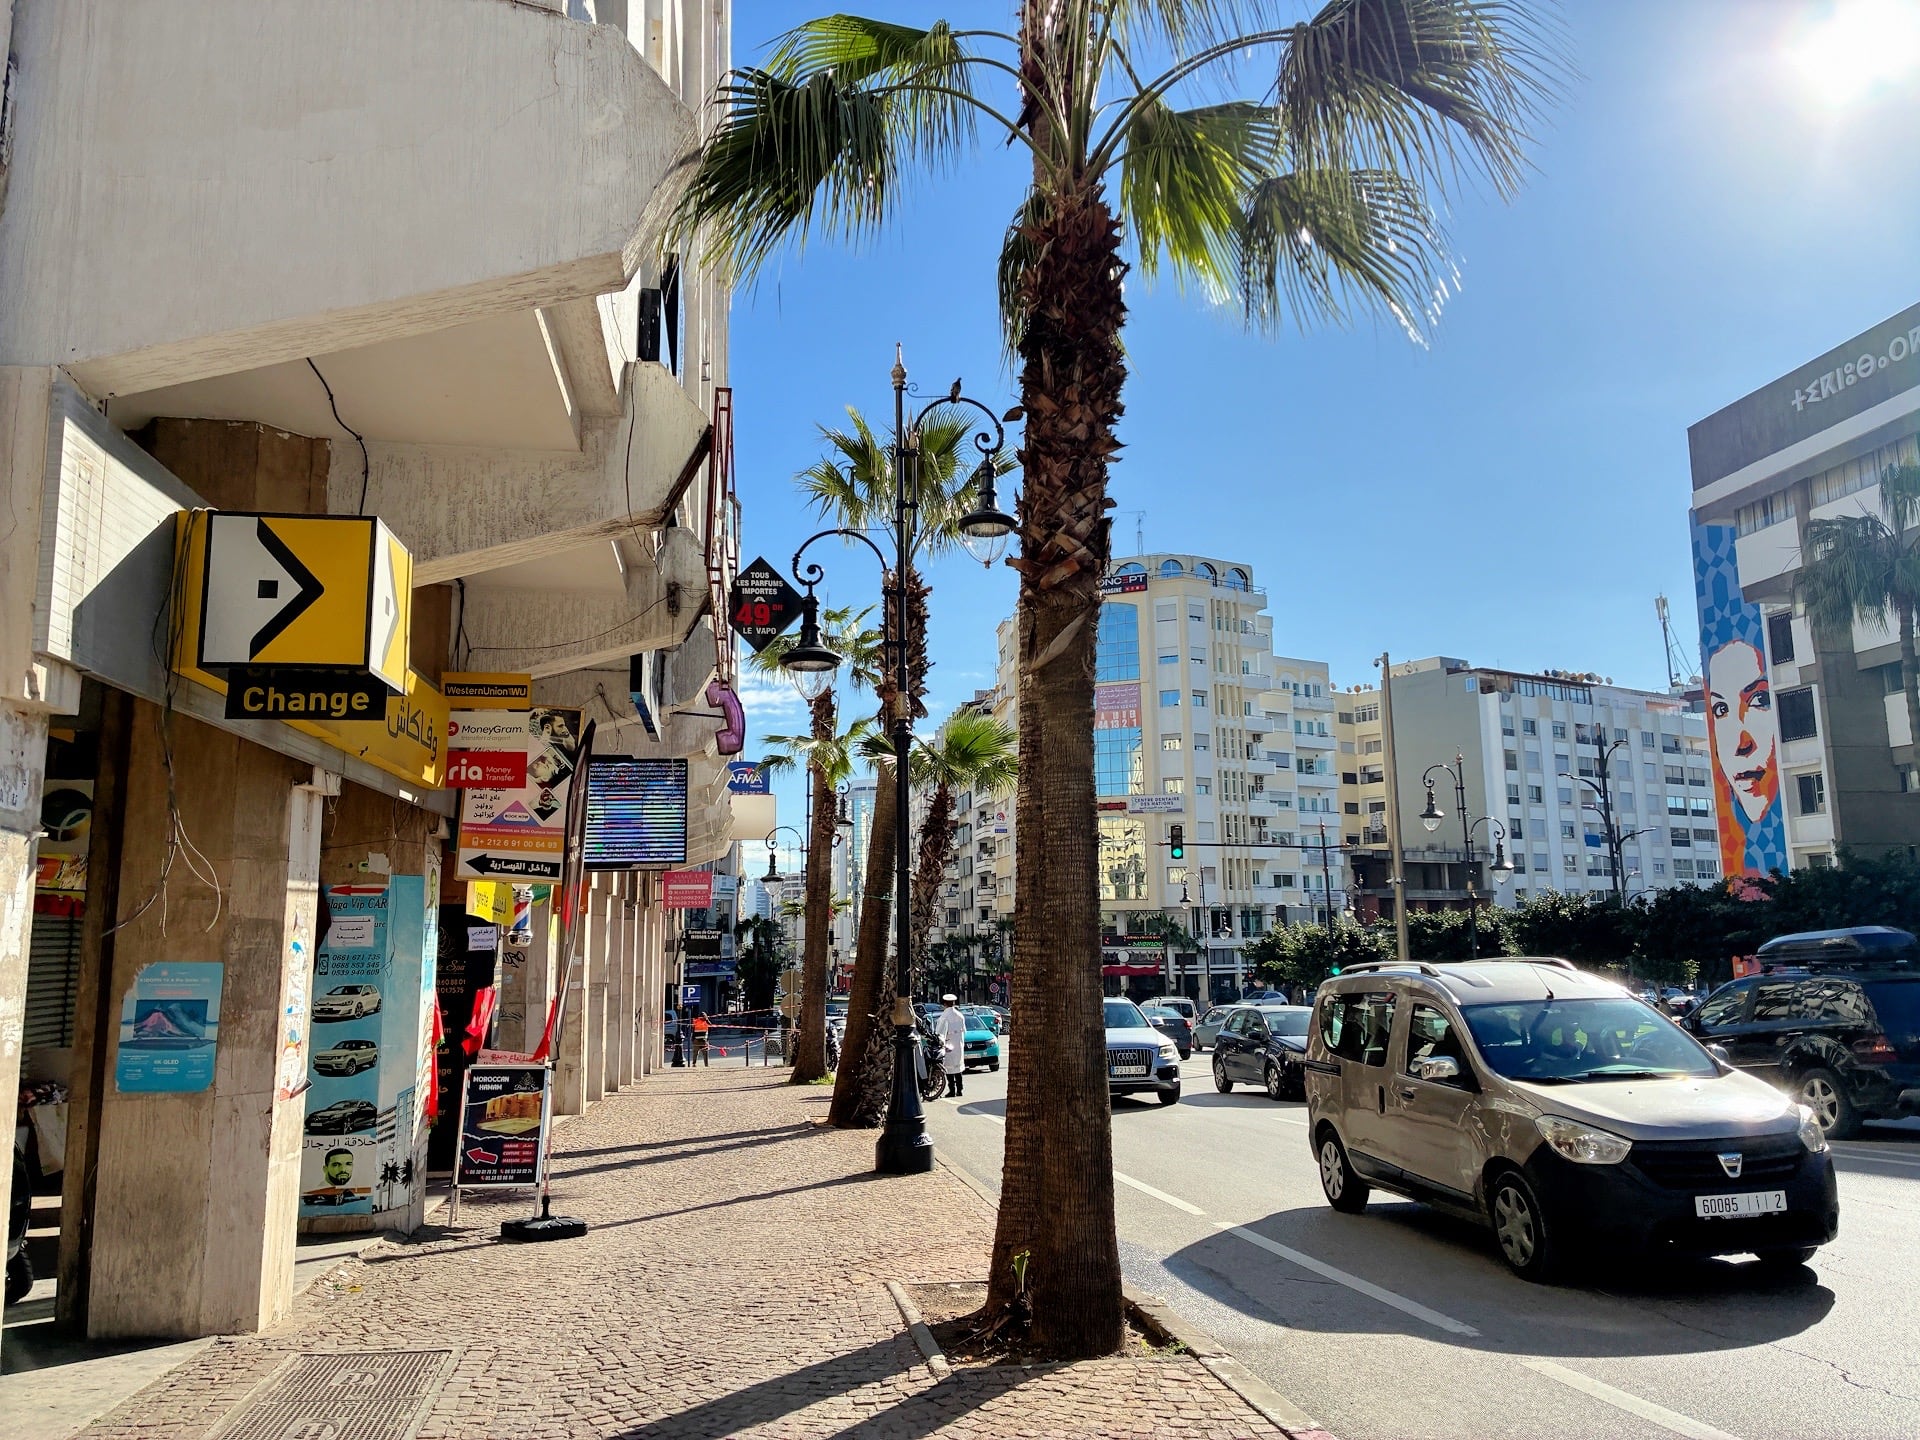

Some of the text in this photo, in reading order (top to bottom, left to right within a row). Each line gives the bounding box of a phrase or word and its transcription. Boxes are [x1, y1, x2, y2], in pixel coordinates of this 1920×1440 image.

[750, 571, 770, 579] TOUS
[736, 579, 784, 587] LES PARFUMS
[741, 587, 778, 595] IMPORTES
[736, 602, 770, 626] 49
[742, 627, 777, 635] LE VAPO
[446, 686, 508, 696] WesternUnion
[243, 686, 370, 718] Change
[448, 758, 483, 781] ria
[486, 766, 512, 775] Money
[486, 774, 516, 782] Transfer
[729, 773, 763, 784] AFMA
[486, 838, 501, 847] 212
[511, 839, 521, 847] 91
[523, 840, 533, 848] 00
[351, 897, 366, 912] Vip
[687, 987, 696, 998] P
[472, 1075, 510, 1083] MOROCCAN
[301, 1137, 377, 1151] حلاقة الرجال
[1702, 1197, 1739, 1214] 60085
[1774, 1193, 1783, 1209] 2
